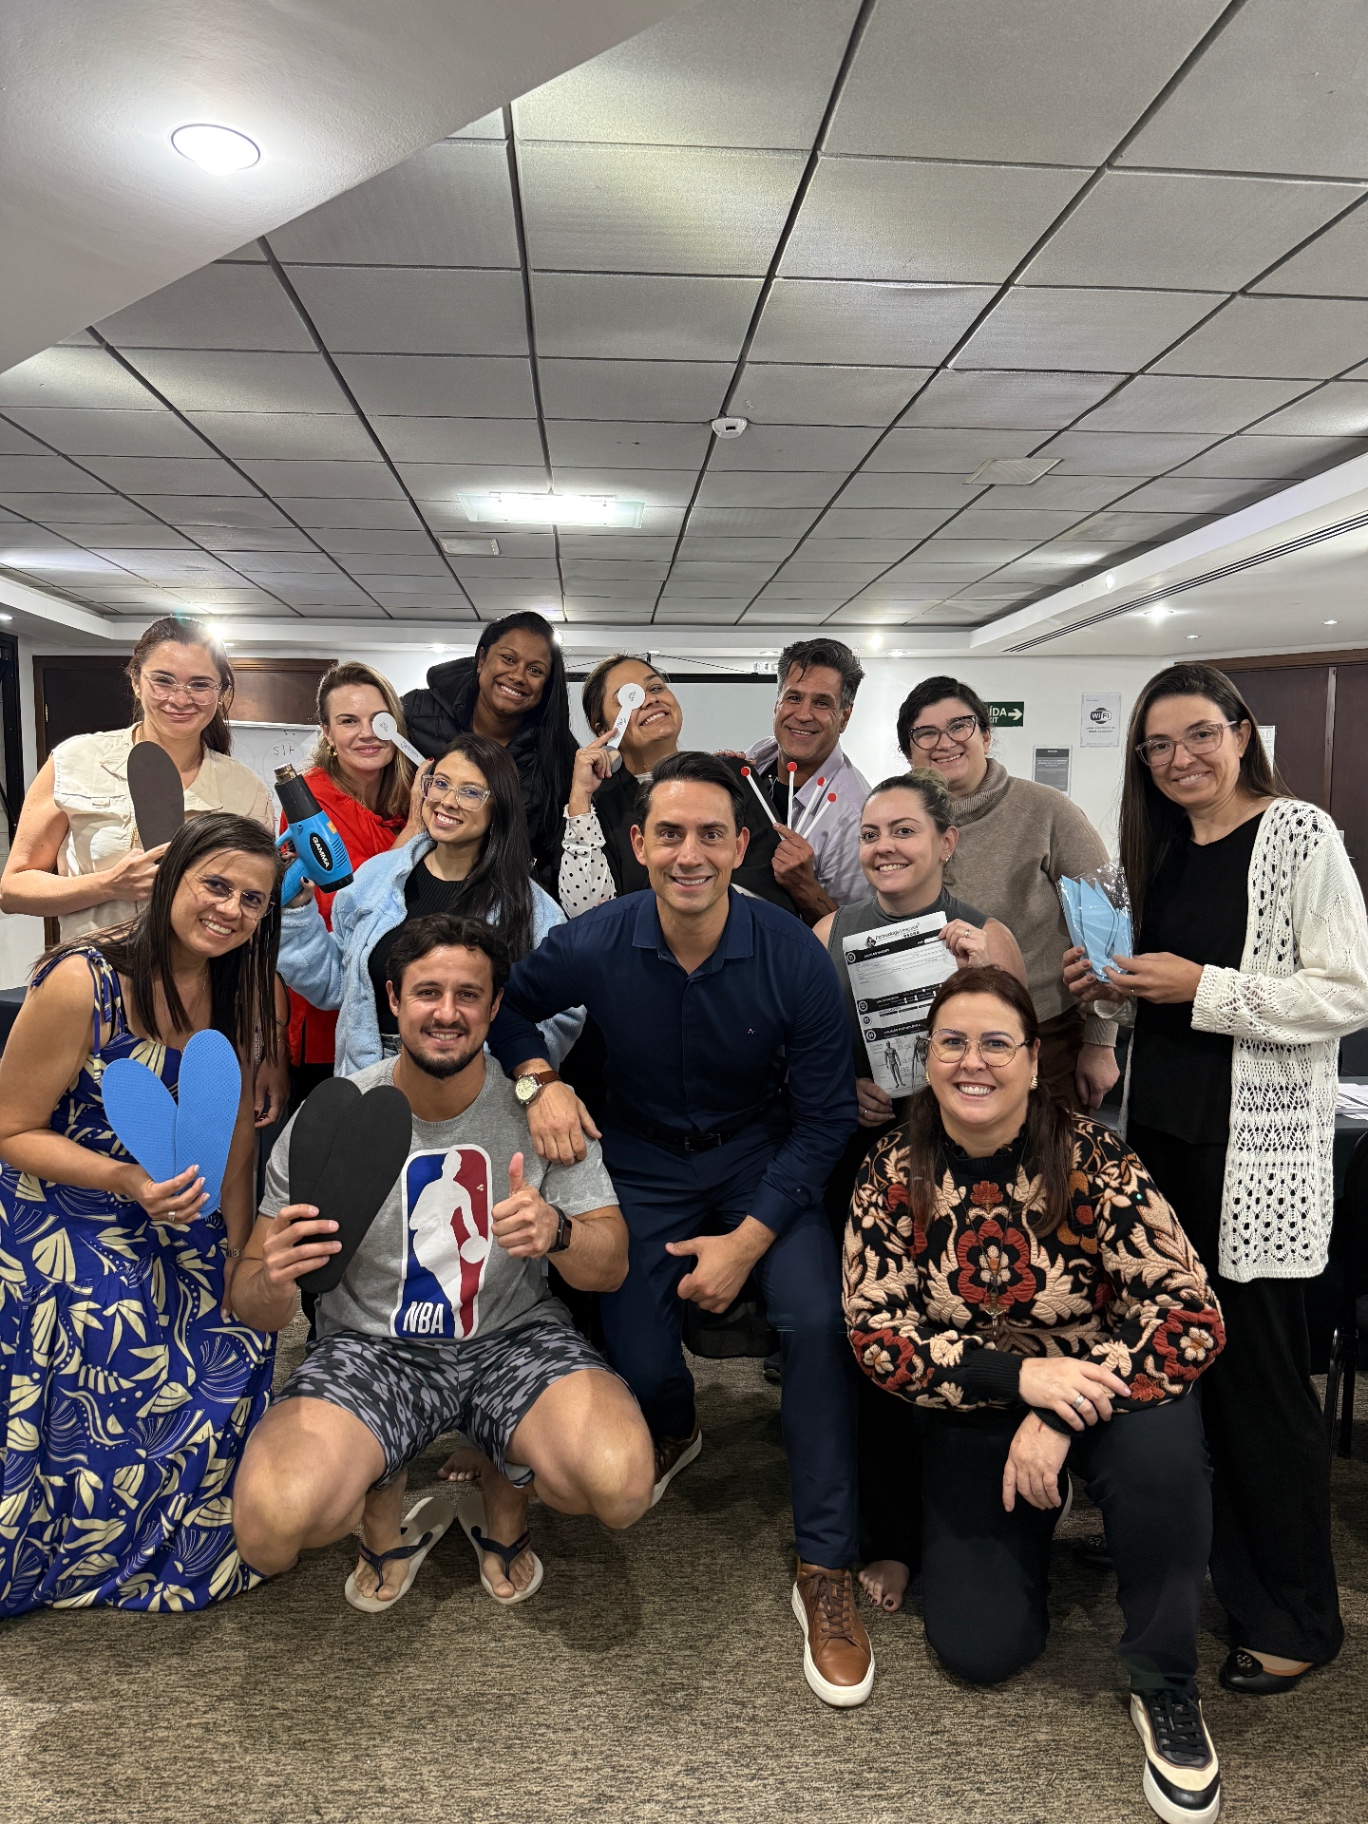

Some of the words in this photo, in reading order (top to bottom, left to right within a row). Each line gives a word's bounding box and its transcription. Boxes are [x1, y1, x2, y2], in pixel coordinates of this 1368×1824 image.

[989, 705, 1007, 717] ÍDA
[312, 836, 330, 868] GAMMA
[402, 1301, 444, 1334] NBA
